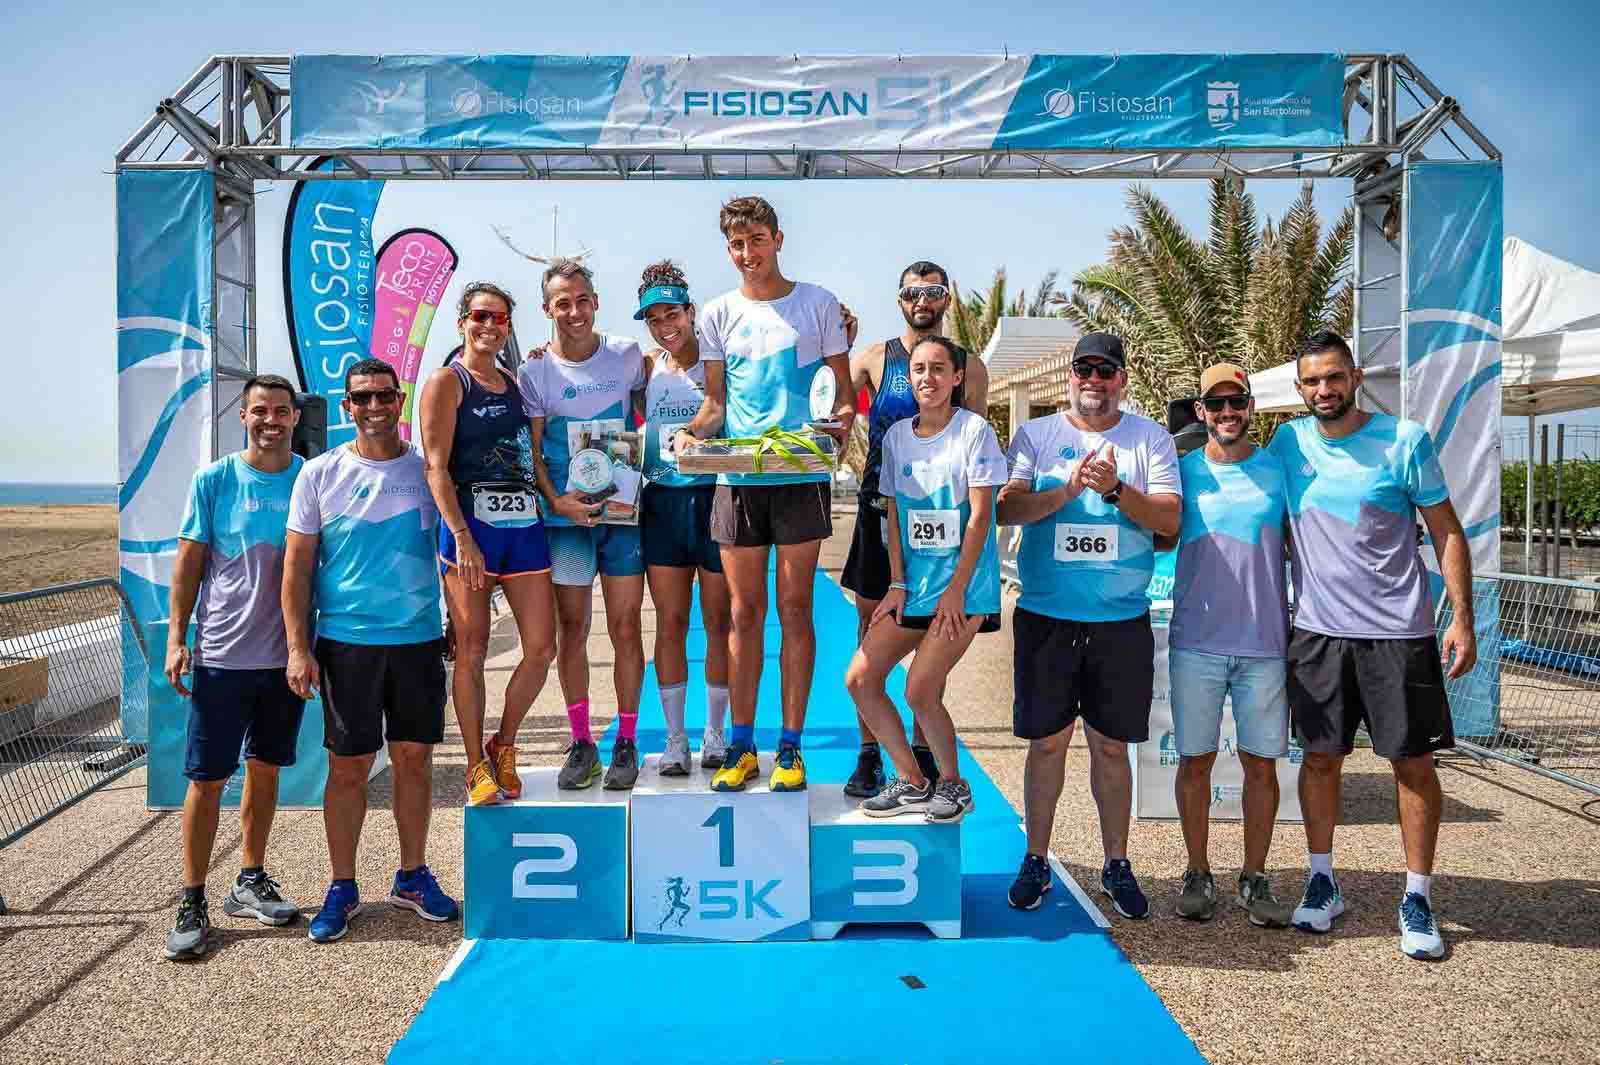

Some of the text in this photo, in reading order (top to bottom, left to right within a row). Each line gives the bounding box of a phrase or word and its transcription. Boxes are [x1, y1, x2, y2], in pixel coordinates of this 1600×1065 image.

[486, 90, 582, 114] Fisiosan
[684, 91, 869, 117] FISIOSAN
[1079, 91, 1173, 113] Fisiosan
[357, 216, 370, 326] FISIOTERAPIA
[659, 405, 700, 417] FisioS
[487, 495, 526, 512] 323
[913, 522, 945, 540] 291
[1065, 536, 1107, 553] 366
[701, 806, 736, 867] 1
[511, 833, 578, 899] 2
[852, 839, 920, 907] 3
[699, 879, 784, 920] 5K
